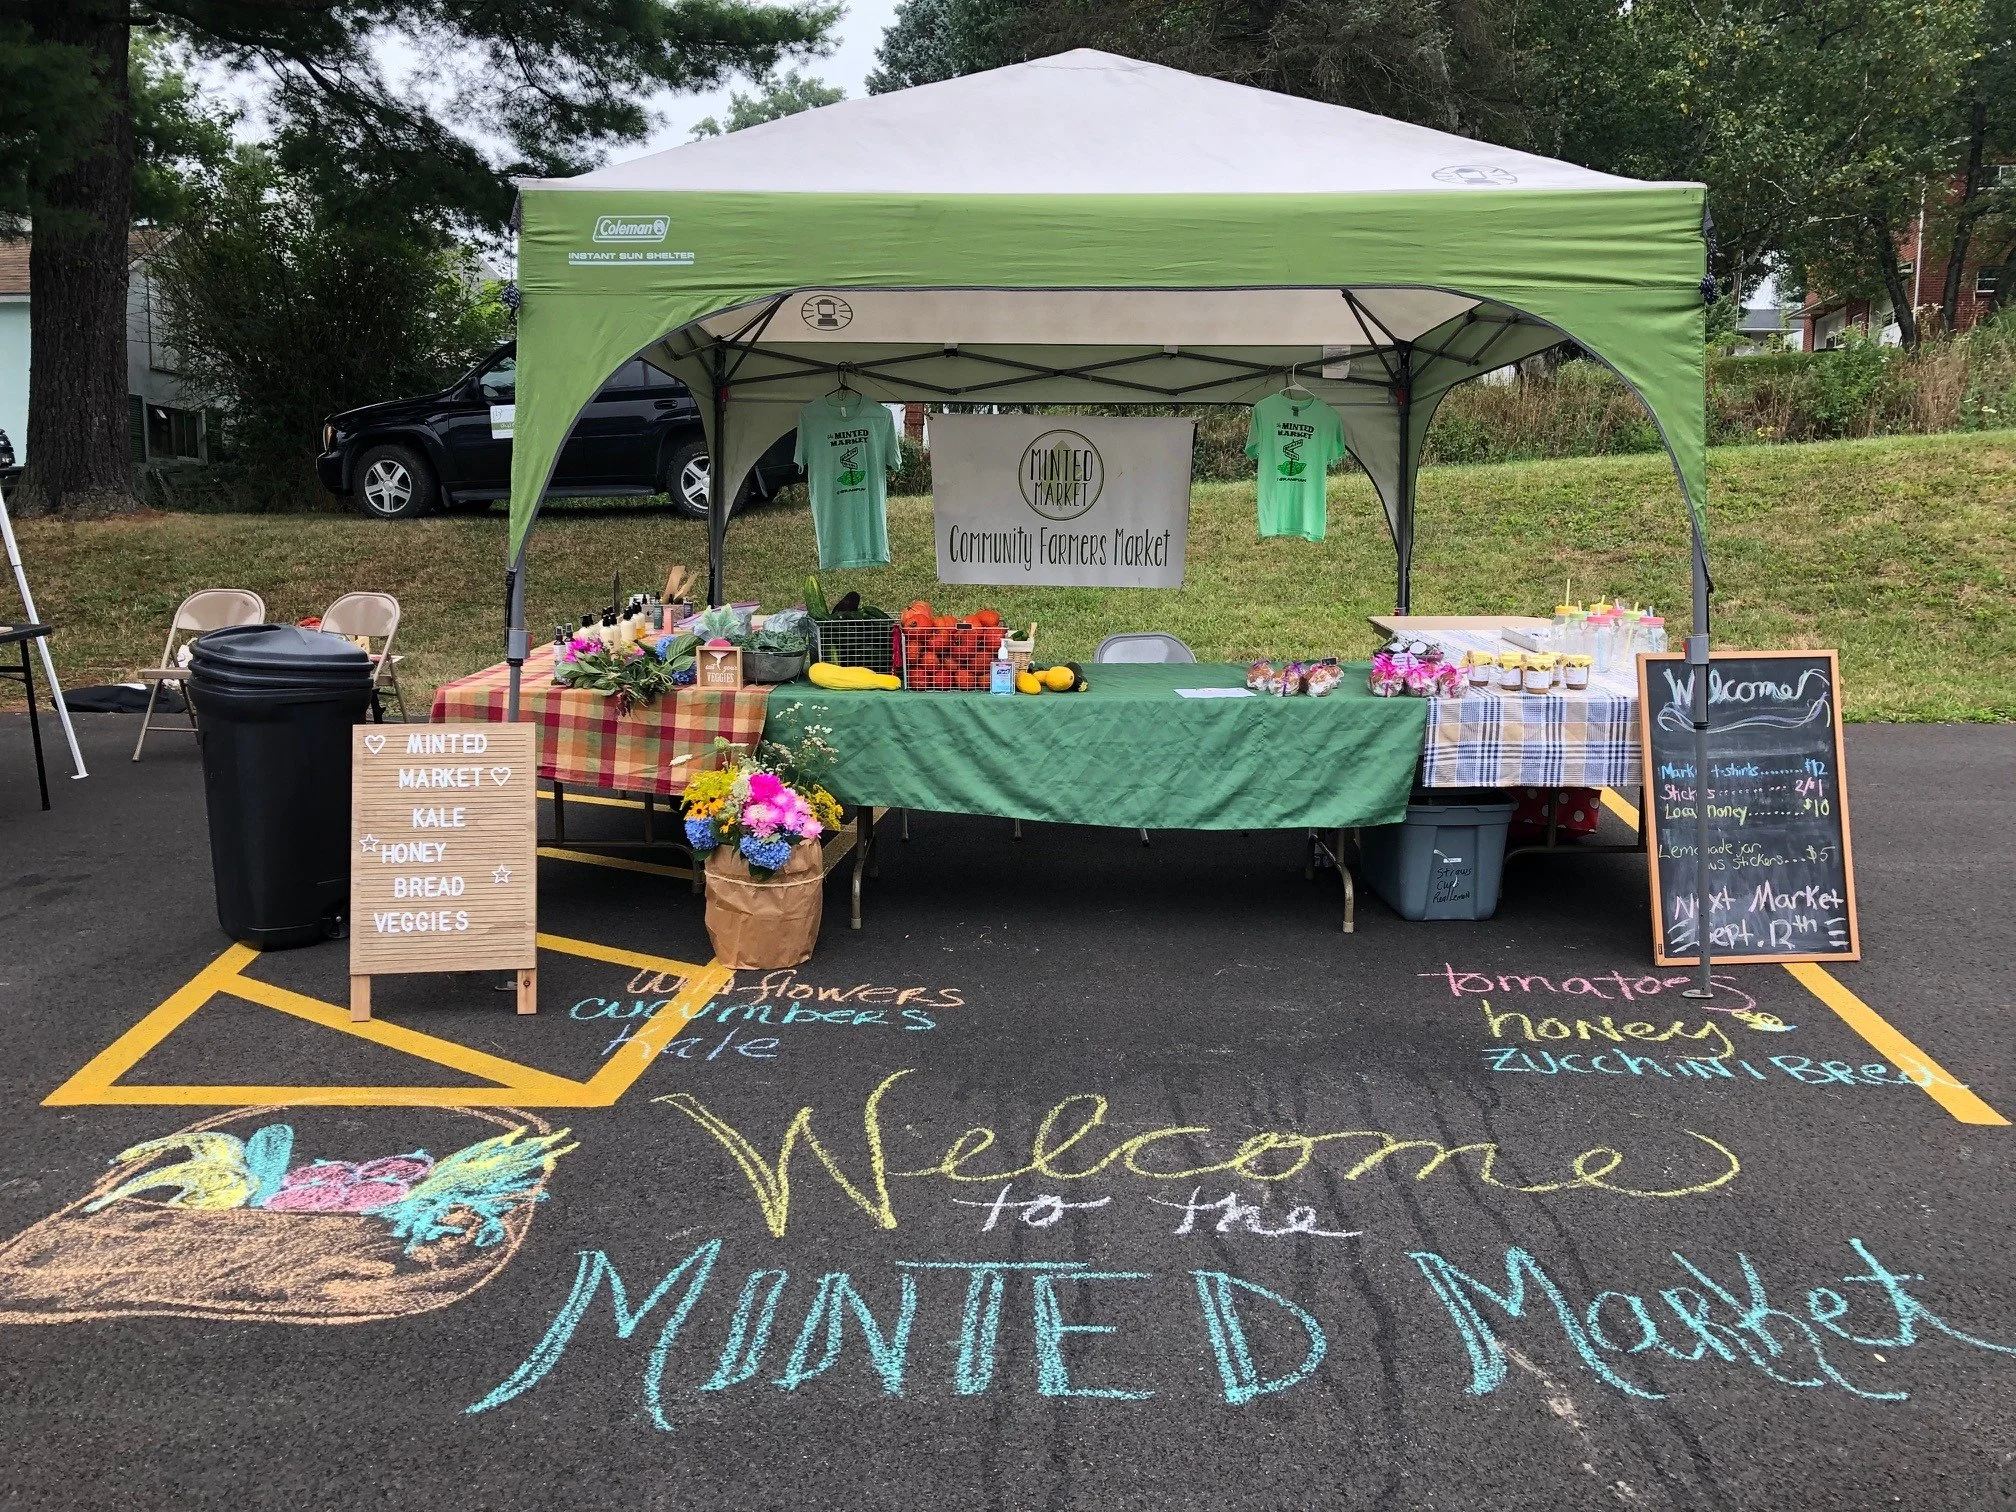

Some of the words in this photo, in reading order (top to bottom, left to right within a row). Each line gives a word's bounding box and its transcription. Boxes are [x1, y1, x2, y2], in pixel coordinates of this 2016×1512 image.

[599, 218, 653, 237] Coleman
[568, 251, 616, 261] INSTANT
[618, 251, 644, 261] SUN
[646, 250, 695, 261] SHELTER
[834, 429, 869, 440] MINTED
[1277, 430, 1313, 440] MARKET
[1281, 422, 1315, 434] MINTED
[830, 436, 869, 447] MARKET
[1030, 448, 1093, 482] MINTED
[1034, 482, 1088, 507] MARKET
[1040, 526, 1107, 567] Farmers
[1113, 528, 1171, 567] Market
[706, 671, 735, 683] VEGGIES
[1662, 667, 1830, 707] Wlcome
[406, 733, 488, 754] MINTED
[398, 766, 485, 789] MARKET
[1661, 762, 1698, 780] Mark
[1660, 783, 1716, 802] Sticks
[412, 807, 467, 829] KALE
[1665, 803, 1698, 820] Loca
[381, 841, 447, 864] HONEY
[1806, 844, 1837, 864] $5
[394, 876, 466, 898] BREAD
[1674, 885, 1737, 920] Nxt
[1747, 879, 1845, 913] Market
[373, 911, 469, 933] VEGGIES
[1697, 918, 1764, 950] ept.
[650, 1068, 1740, 1238] Welcome
[953, 1182, 1111, 1232] to
[1148, 1186, 1363, 1237] the
[464, 1238, 1328, 1432] MINTED
[1403, 1236, 2016, 1401] Market
